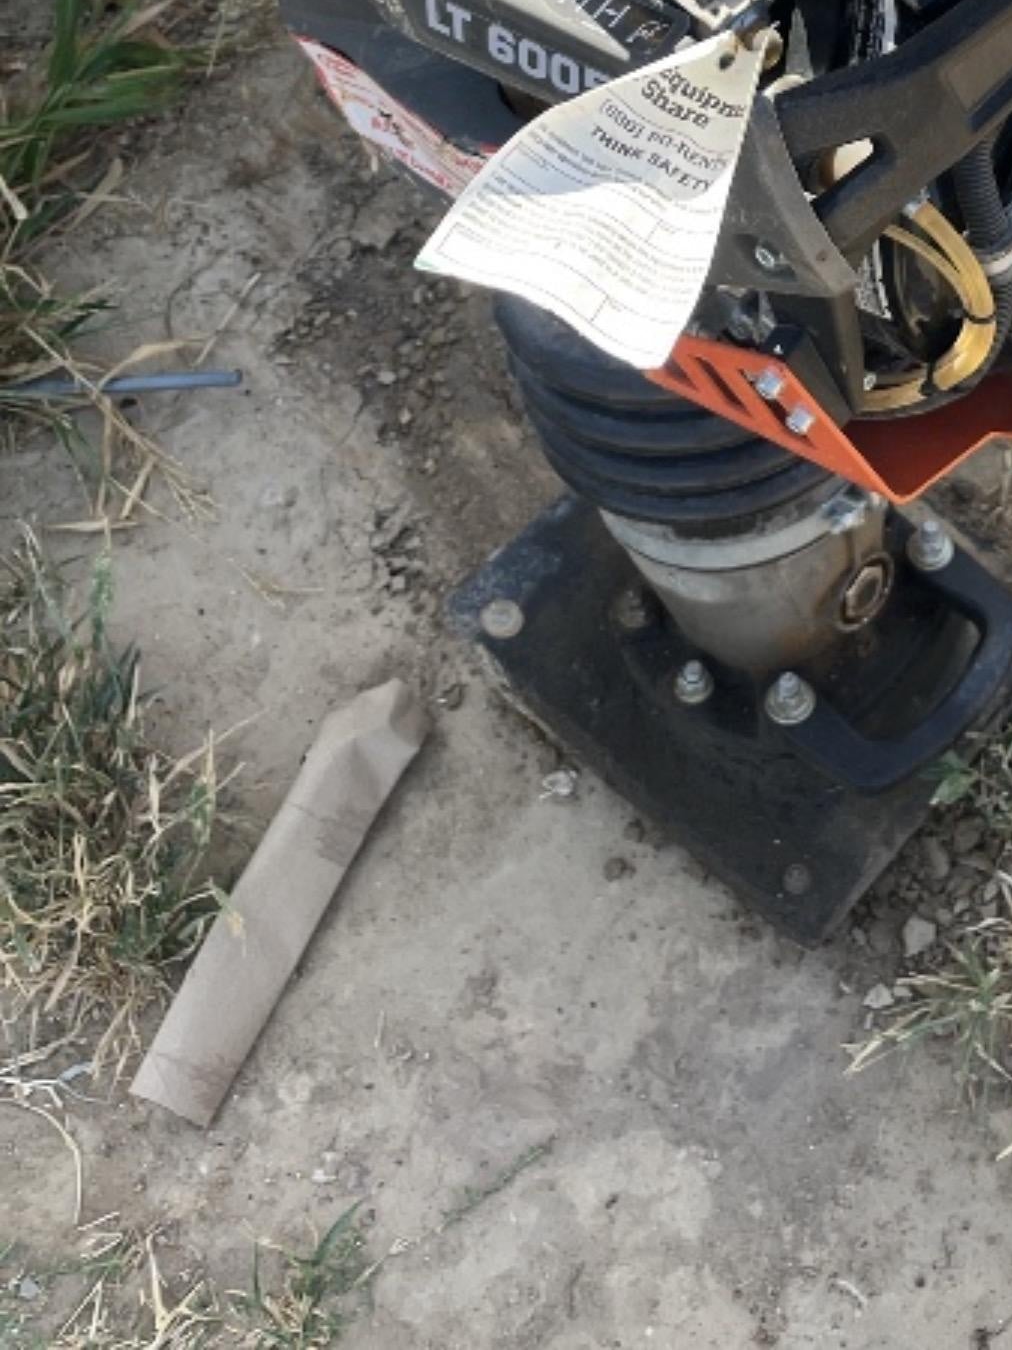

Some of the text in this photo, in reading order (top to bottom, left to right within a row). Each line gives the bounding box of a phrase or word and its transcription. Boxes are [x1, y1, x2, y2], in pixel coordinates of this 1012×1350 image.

[641, 78, 709, 128] Share
[592, 125, 715, 191] THINK SAFETY
